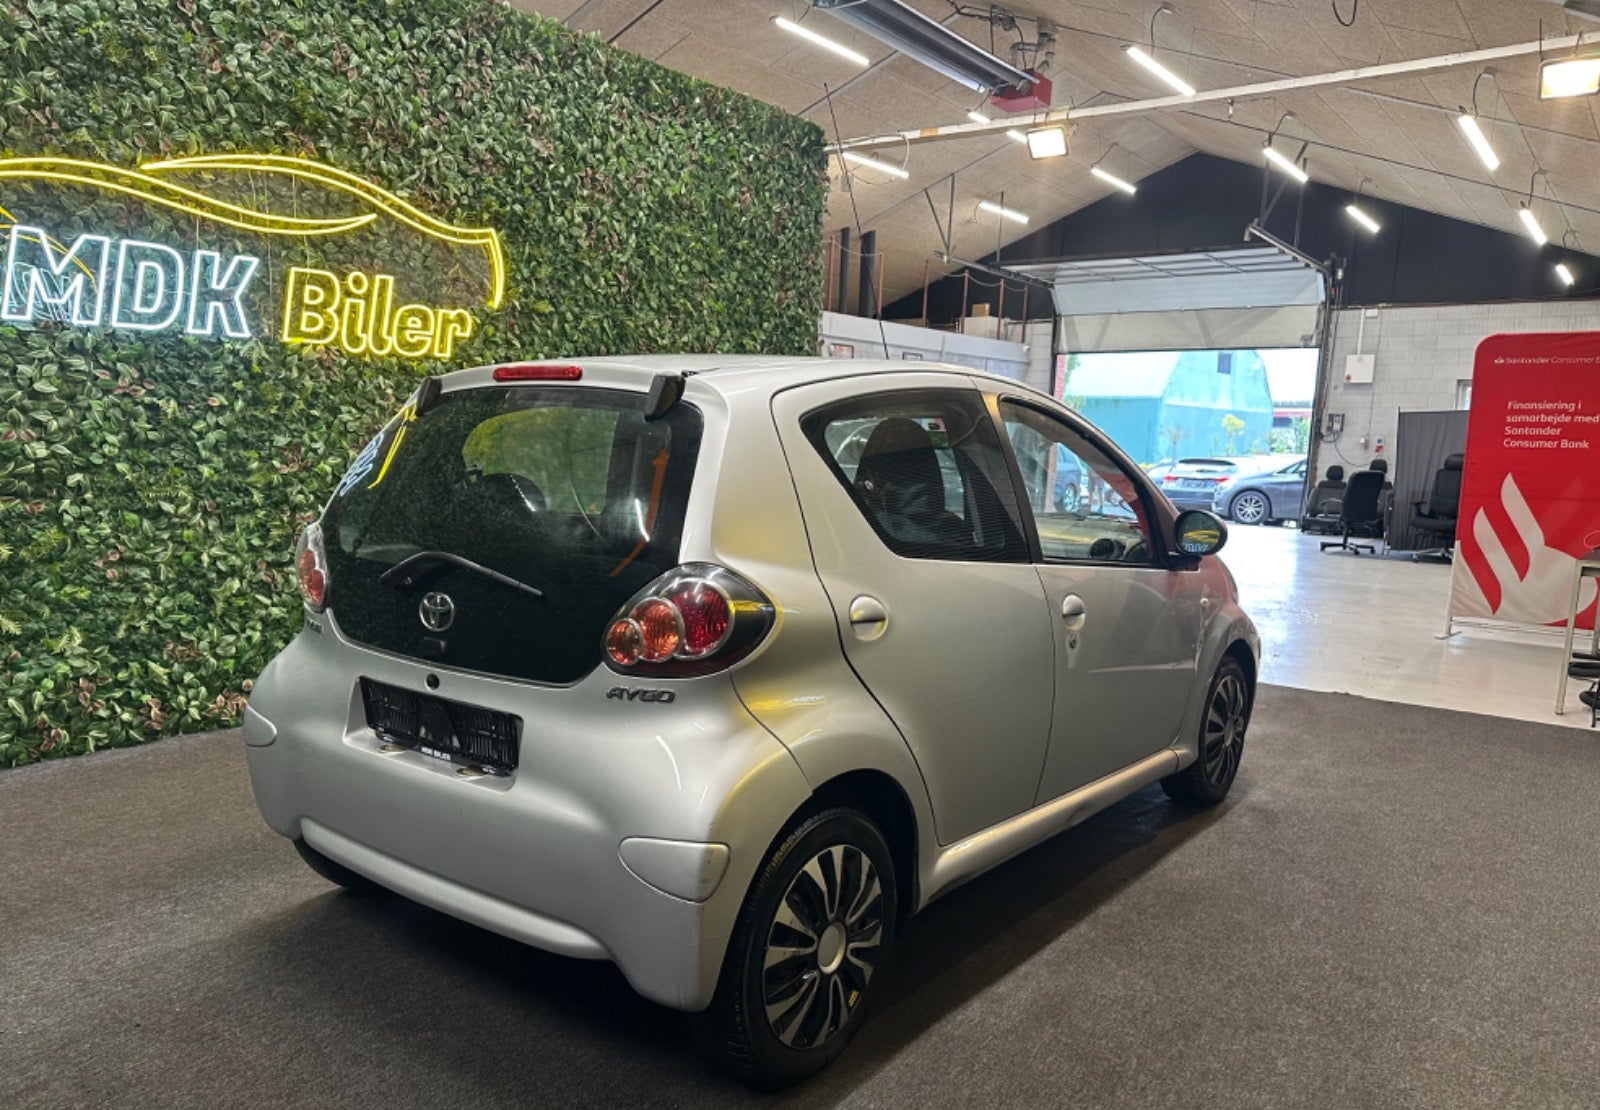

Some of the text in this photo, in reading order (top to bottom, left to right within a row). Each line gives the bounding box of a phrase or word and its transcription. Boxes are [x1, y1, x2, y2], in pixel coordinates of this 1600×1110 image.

[2, 225, 473, 358] MDK Biler
[1507, 400, 1576, 412] Finansiering
[1506, 413, 1600, 425] samarbejde med
[1504, 426, 1562, 435] Santander
[1503, 438, 1590, 449] Consumer Bank
[606, 686, 676, 703] AYGO
